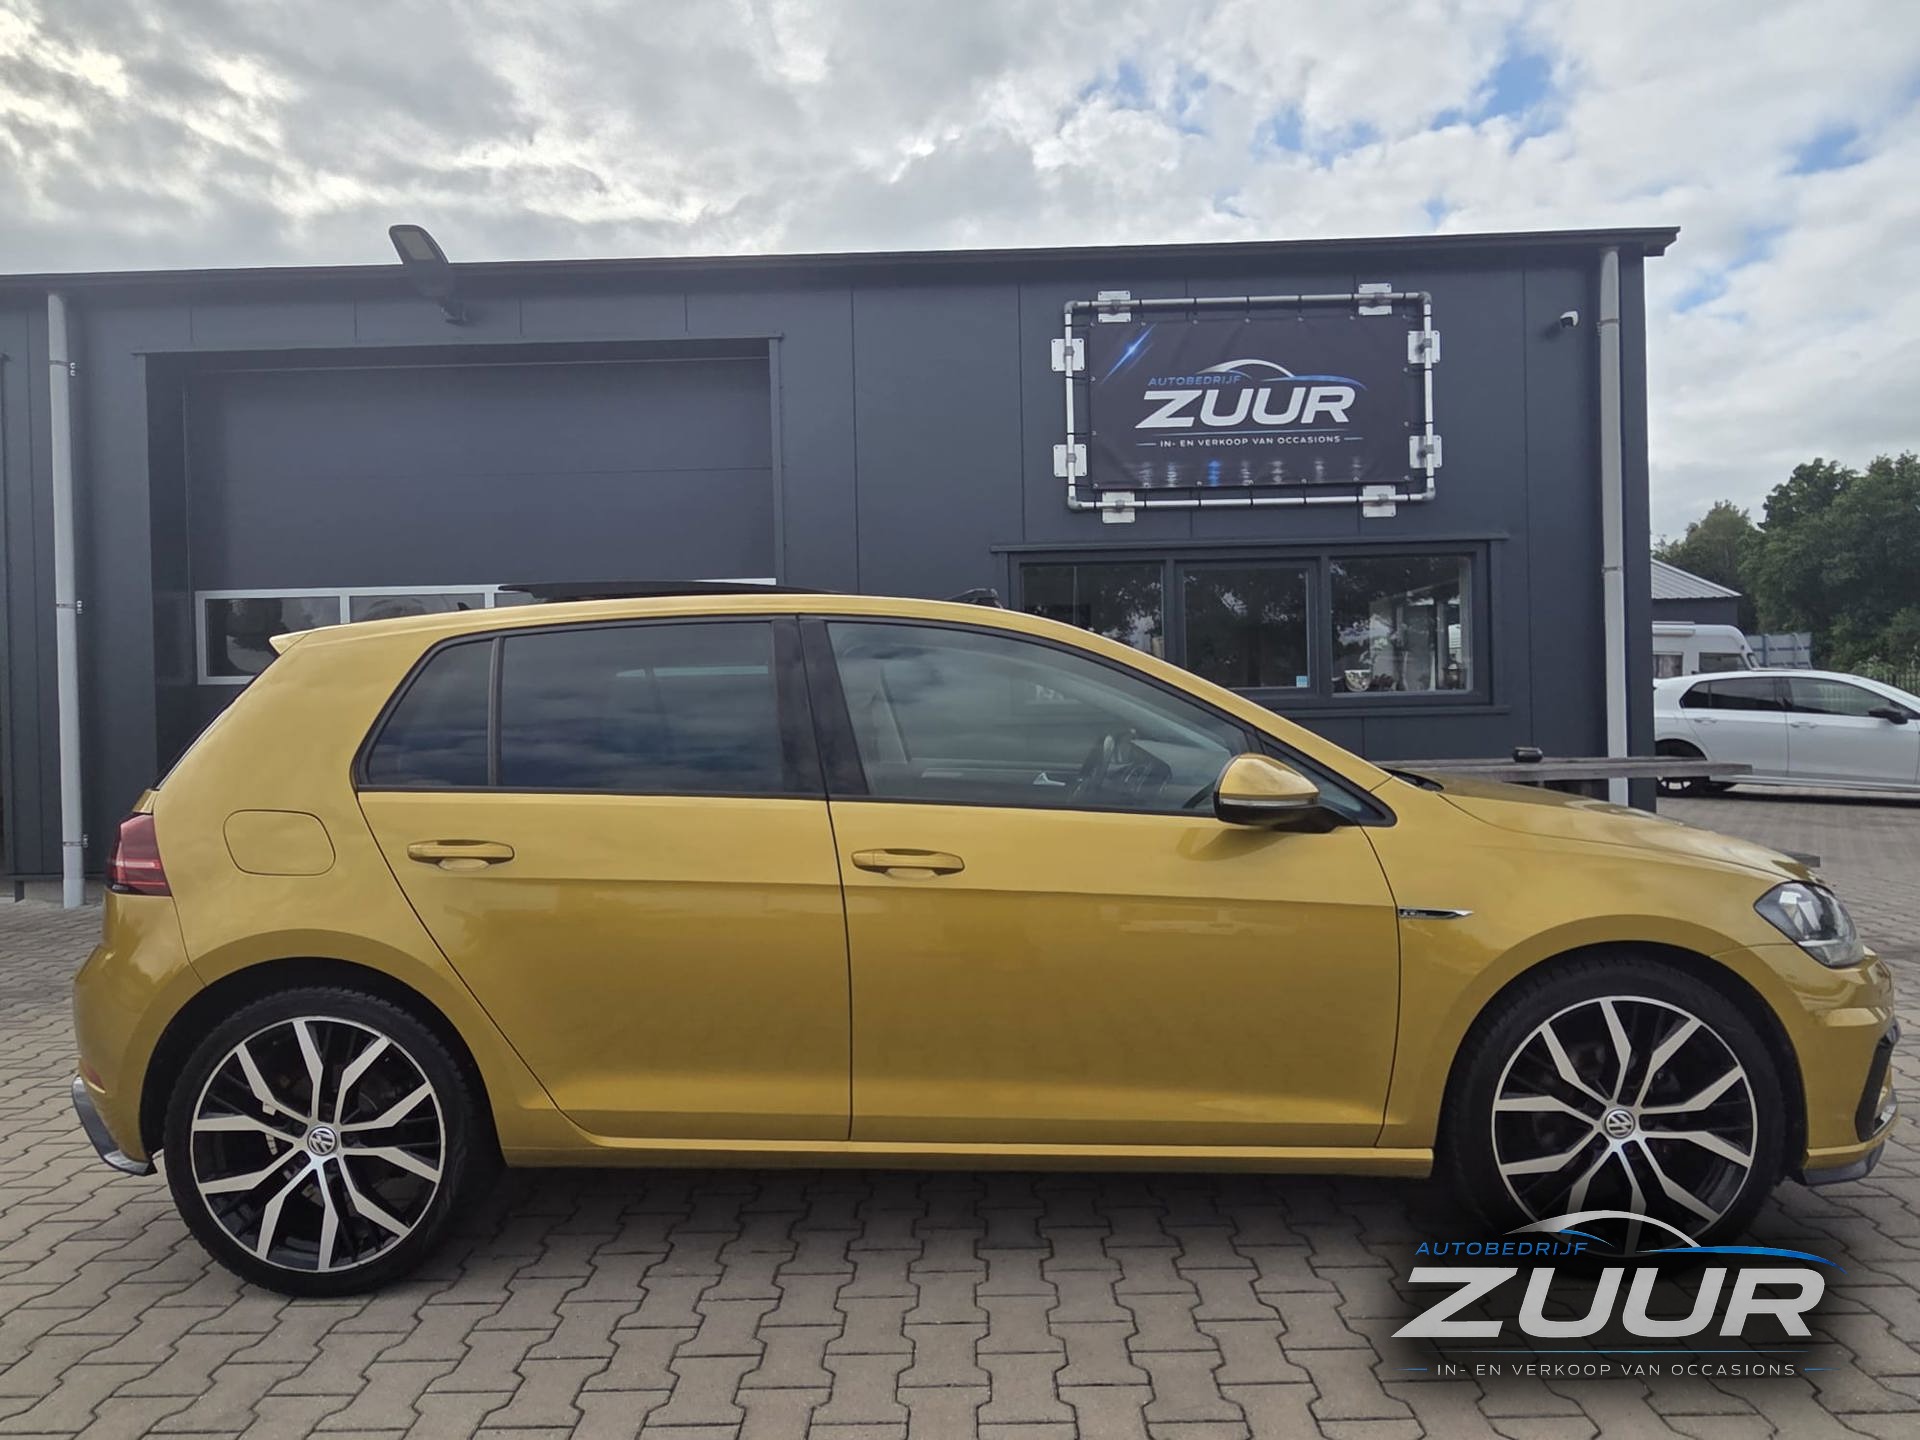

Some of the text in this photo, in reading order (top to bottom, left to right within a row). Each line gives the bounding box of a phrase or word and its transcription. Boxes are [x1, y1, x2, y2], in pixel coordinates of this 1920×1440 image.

[1148, 375, 1241, 386] AUTOBEDRIJF
[1134, 386, 1355, 429] ZUUR
[1160, 435, 1341, 448] IN- EN VERKOOP VAN OCCASIONS
